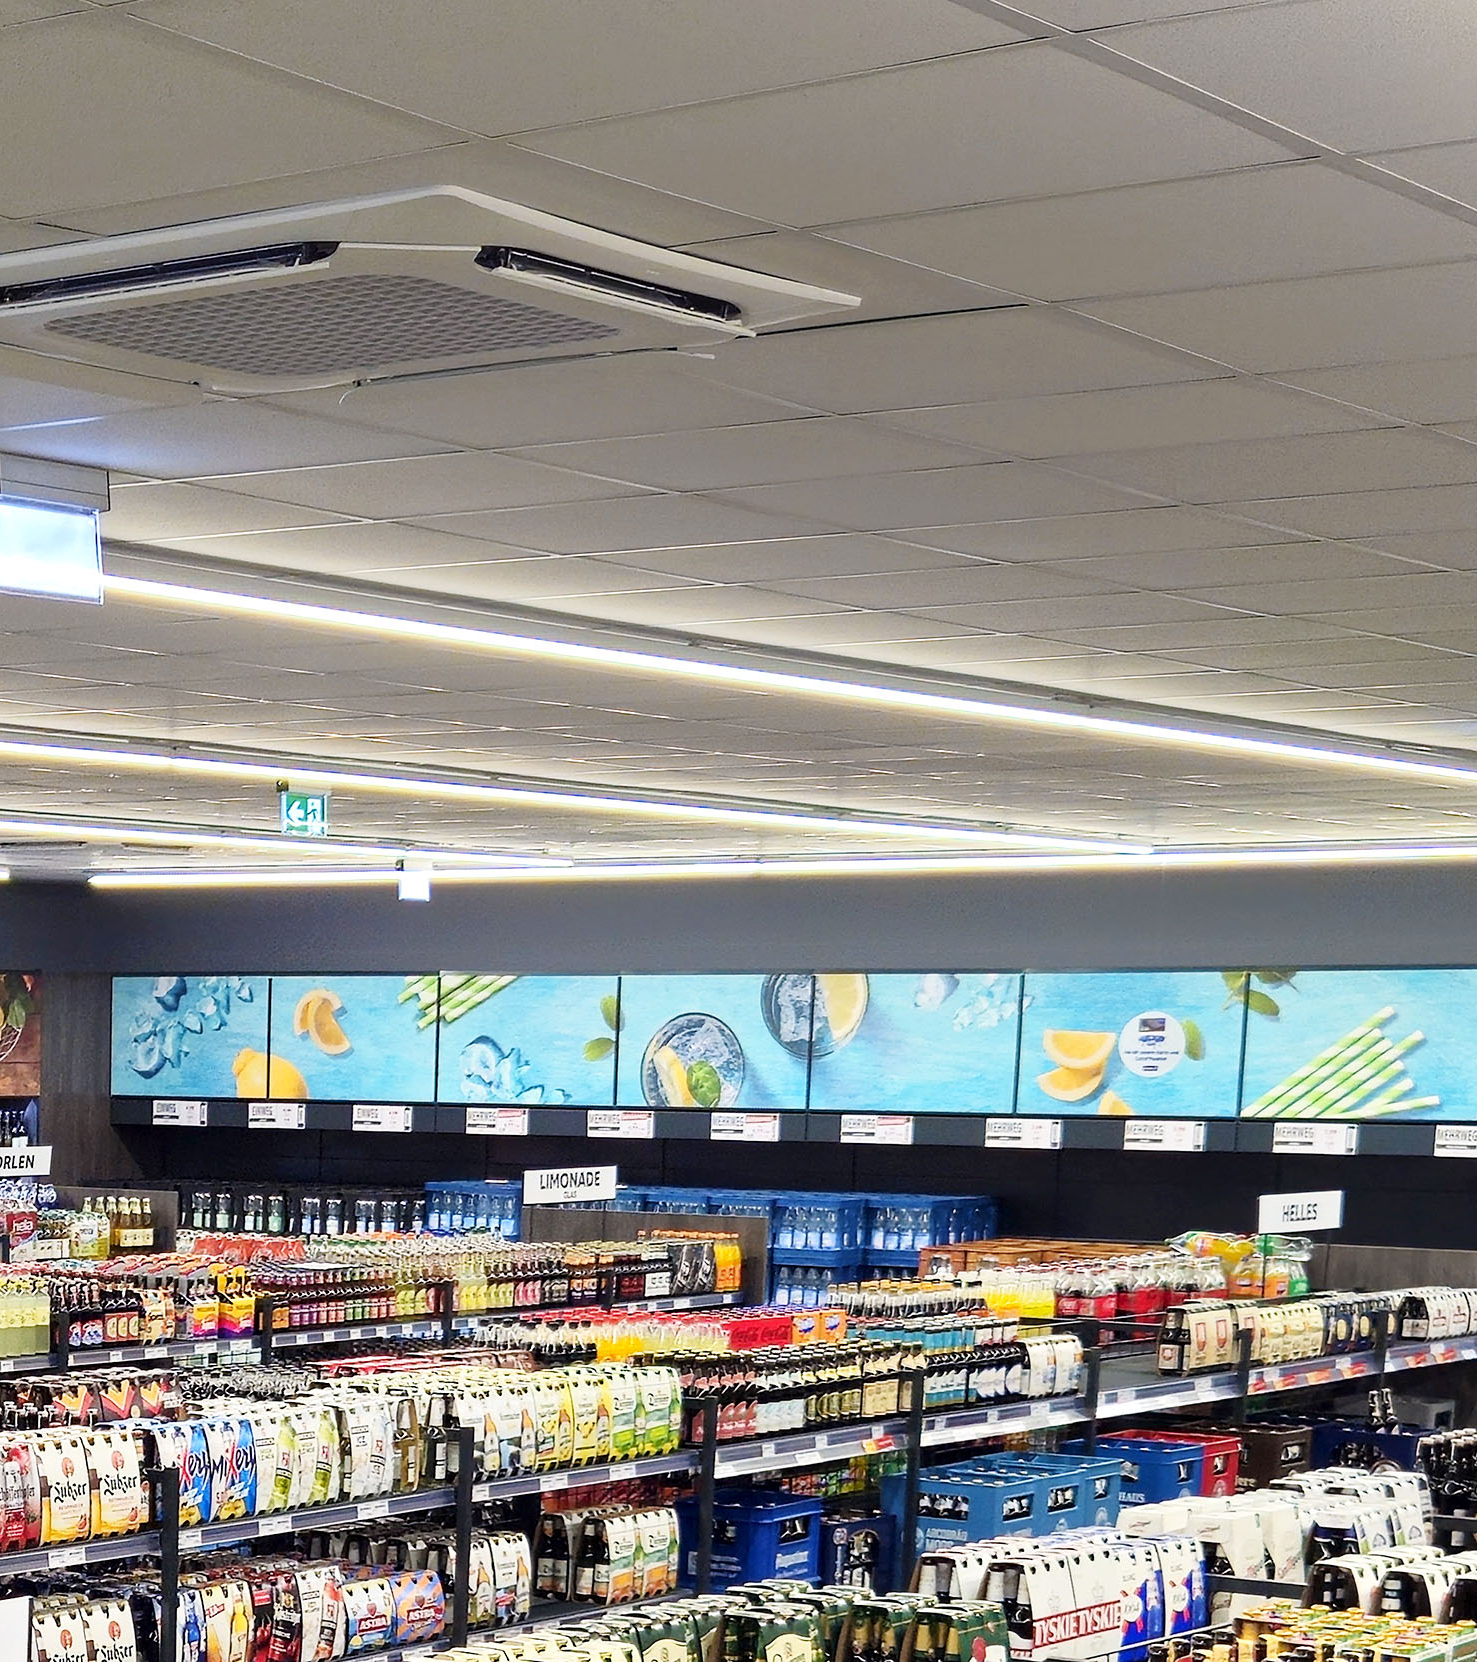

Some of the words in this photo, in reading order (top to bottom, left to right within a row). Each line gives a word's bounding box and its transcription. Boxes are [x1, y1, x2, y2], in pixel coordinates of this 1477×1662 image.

[1436, 1129, 1477, 1143] MEHRWEG
[539, 1171, 600, 1190] LIMONADE
[1282, 1203, 1317, 1222] HELLES
[51, 1478, 87, 1501] Lübzer
[104, 1472, 138, 1494] Lübzer
[360, 1615, 388, 1631] ASTRA
[1077, 1602, 1122, 1634] TYSKIE
[1033, 1613, 1078, 1646] TYSKIE
